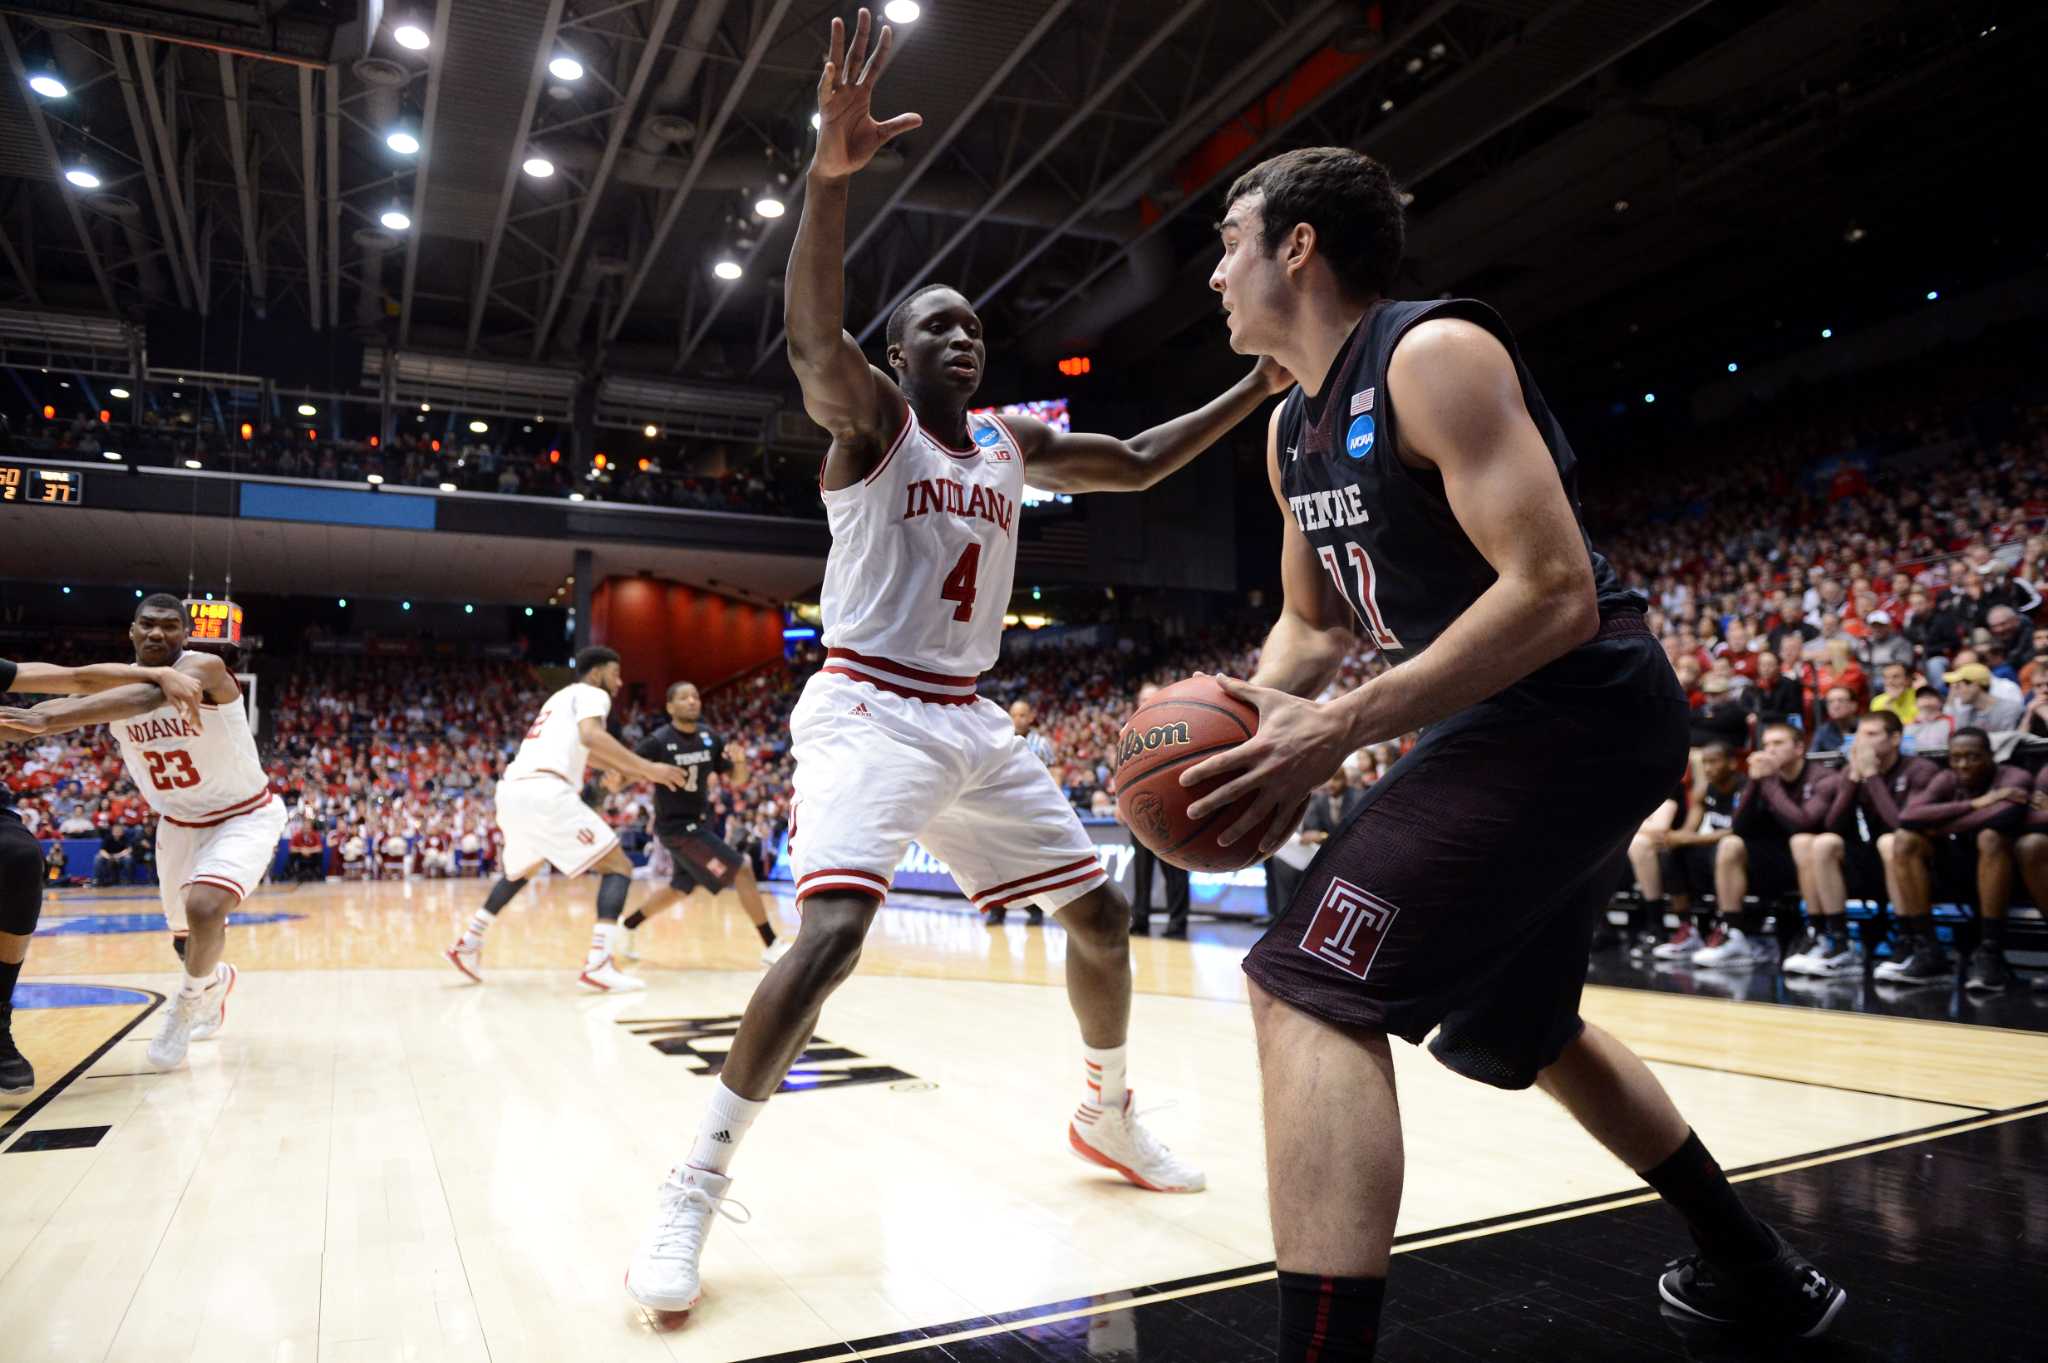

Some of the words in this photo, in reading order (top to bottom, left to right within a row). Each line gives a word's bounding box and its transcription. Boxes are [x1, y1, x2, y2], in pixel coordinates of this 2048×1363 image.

[1350, 432, 1374, 450] NCAA
[42, 483, 70, 502] 37
[940, 542, 982, 623] 4
[1316, 541, 1404, 650] 11
[126, 718, 202, 743] NDIANA
[142, 749, 202, 791] 23
